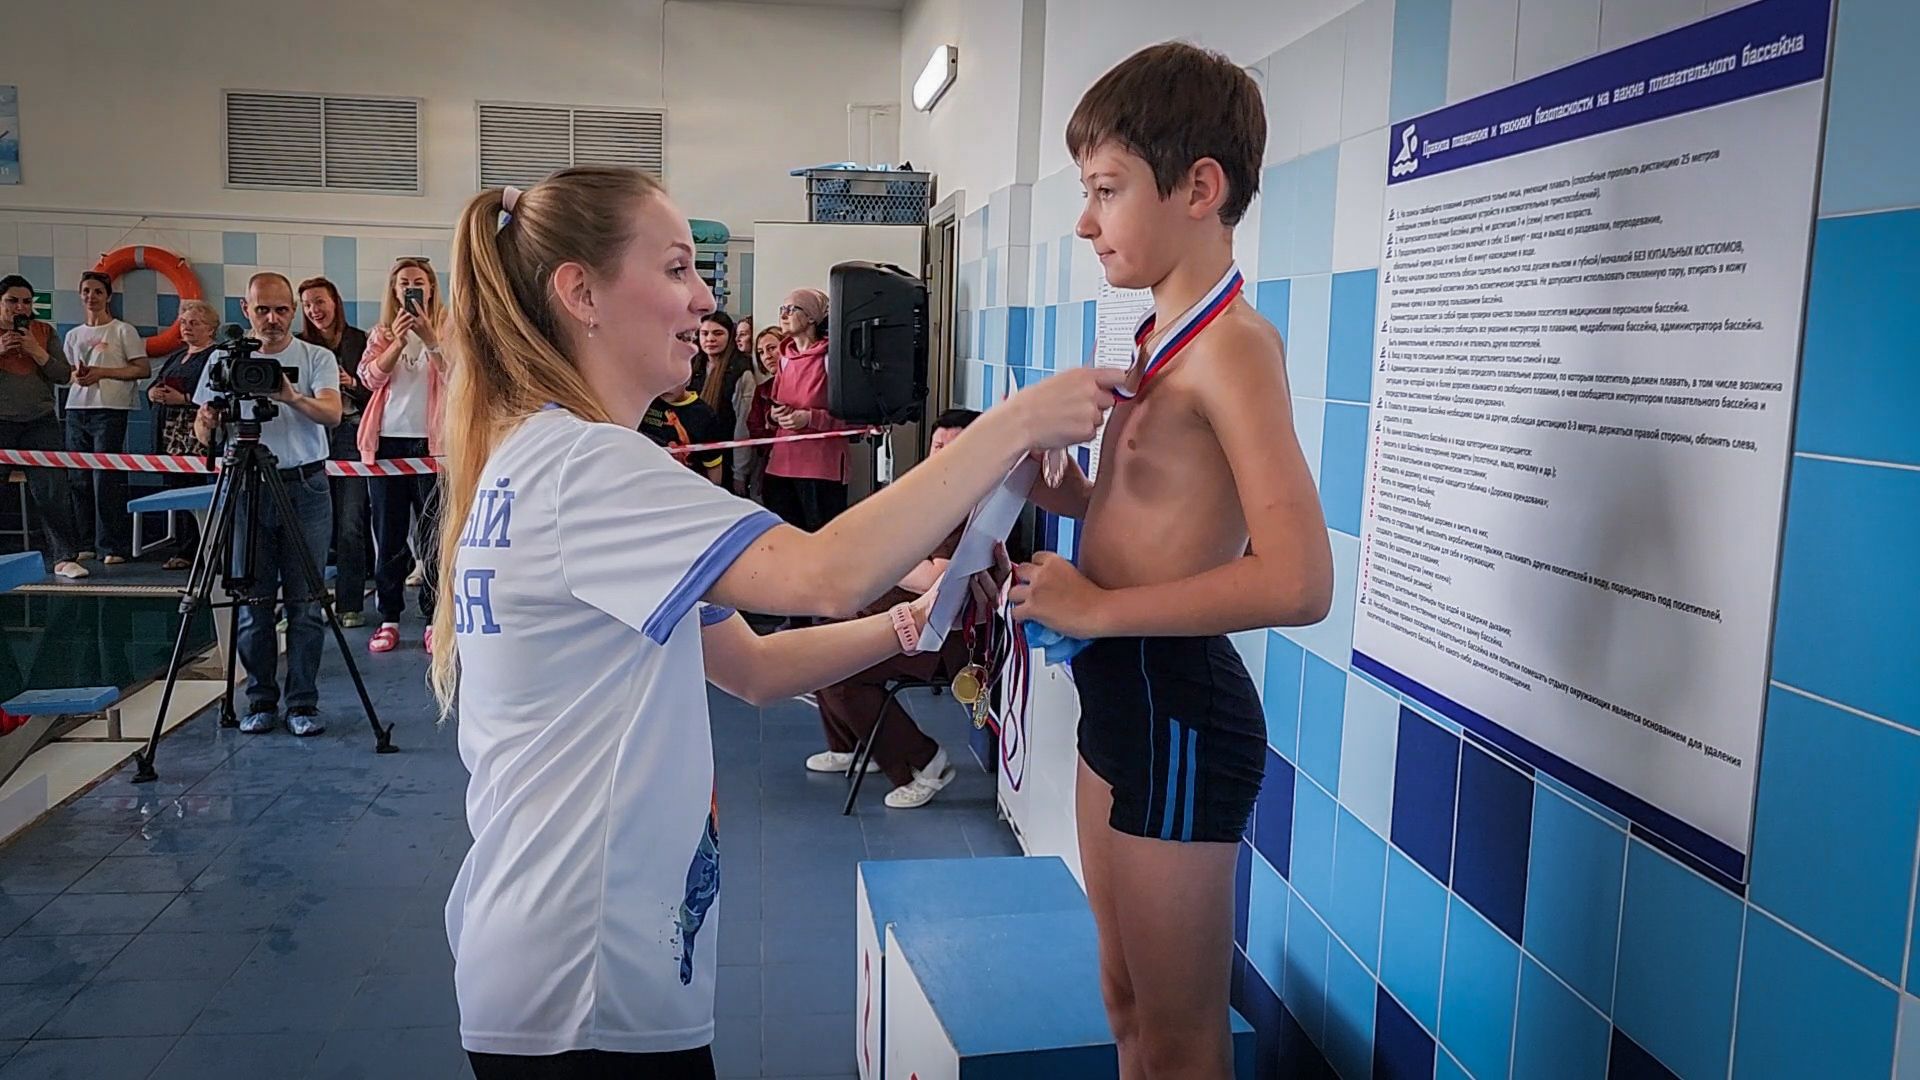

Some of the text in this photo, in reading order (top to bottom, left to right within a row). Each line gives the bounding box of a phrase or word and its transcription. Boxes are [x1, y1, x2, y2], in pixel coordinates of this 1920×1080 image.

[1500, 114, 1531, 133] техники
[1535, 96, 1593, 124] безопасности
[1597, 91, 1609, 106] на
[1613, 81, 1644, 101] ванне
[1649, 53, 1735, 91] плавательного
[1742, 33, 1805, 65] бассейна
[1571, 171, 1605, 187] (способные
[1607, 165, 1639, 180] проплыть
[1639, 157, 1679, 174] дистанцию
[1681, 152, 1690, 164] 25
[1691, 149, 1719, 162] метров
[1550, 187, 1600, 206] приспособлений).
[1565, 208, 1592, 219] возраста.
[1566, 227, 1573, 235] из
[1574, 222, 1610, 235] раздевалки,
[1612, 215, 1662, 230] переодевание,
[1578, 250, 1632, 267] губкой/мочалкой
[1633, 248, 1646, 260] БЕЗ
[1647, 243, 1693, 259] КУПАЛЬНЫХ
[1694, 238, 1743, 254] КОСТЮМОВ,
[1547, 275, 1581, 286] допускается
[1583, 271, 1624, 282] использовать
[1626, 268, 1666, 279] стеклянную
[1668, 267, 1685, 277] тару,
[1687, 264, 1717, 276] втирать
[1725, 262, 1746, 273] кожу
[1568, 307, 1611, 317] медицинским
[1612, 305, 1652, 316] персоналом
[1654, 301, 1688, 313] бассейна.
[1549, 324, 1577, 333] плаванию,
[1579, 321, 1624, 333] медработника
[1626, 320, 1658, 333] бассейна,
[1660, 322, 1722, 333] администратора
[1724, 318, 1763, 330] бассейна.
[1567, 373, 1593, 383] которым
[1595, 374, 1630, 383] посетитель
[1631, 376, 1658, 386] должен
[1659, 377, 1690, 389] плавать,
[1698, 379, 1713, 388] том
[1714, 379, 1737, 389] числе
[1739, 380, 1782, 391] возможна
[1566, 389, 1577, 397] чем
[1578, 388, 1614, 400] сообщается
[1615, 392, 1663, 404] инструктором
[1664, 395, 1720, 407] плавательного
[1721, 396, 1758, 410] бассейна
[1536, 419, 1566, 430] дистанцию
[1567, 420, 1576, 430] 2-3
[1577, 423, 1596, 434] метра,
[1598, 425, 1632, 436] держаться
[1634, 428, 1659, 439] правой
[1660, 432, 1693, 445] стороны,
[1695, 433, 1730, 447] обгонять
[1732, 439, 1757, 452] слева,
[1532, 559, 1550, 571] других
[1552, 565, 1587, 582] посетителей
[1593, 577, 1609, 590] воду,
[1611, 582, 1656, 602] подныривать
[1657, 595, 1671, 609] под
[1672, 599, 1721, 624] посетителей,
[1521, 665, 1547, 683] помешать
[1548, 676, 1568, 694] отдыху
[1569, 686, 1610, 710] окружающих
[1611, 704, 1641, 724] является
[1642, 717, 1686, 744] основанием
[1687, 737, 1702, 751] для
[1703, 744, 1741, 768] удаления
